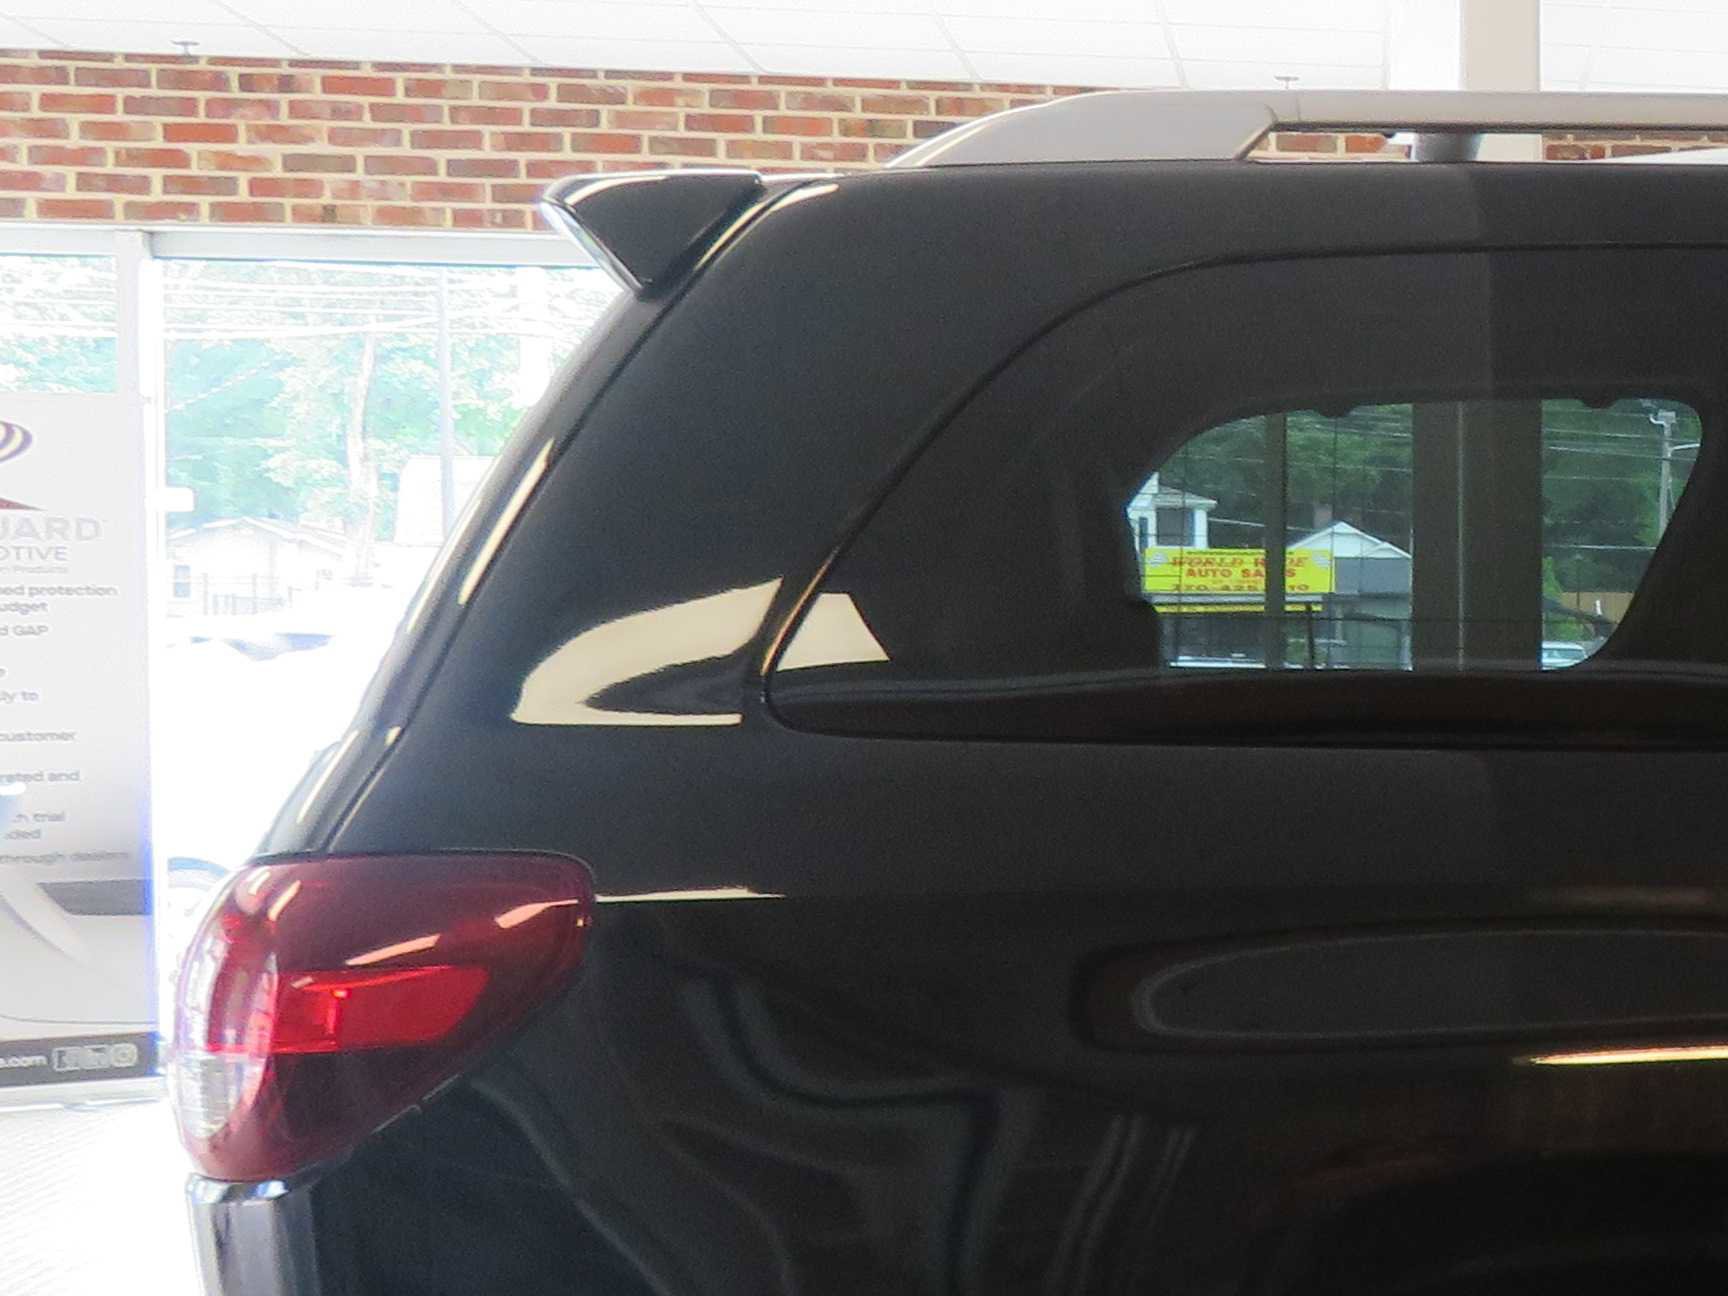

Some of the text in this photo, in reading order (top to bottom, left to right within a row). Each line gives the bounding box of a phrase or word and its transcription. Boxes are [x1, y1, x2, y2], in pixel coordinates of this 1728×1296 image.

[1185, 568, 1297, 578] AUTO SAS
[29, 586, 120, 599] protection
[13, 625, 49, 636] GAP
